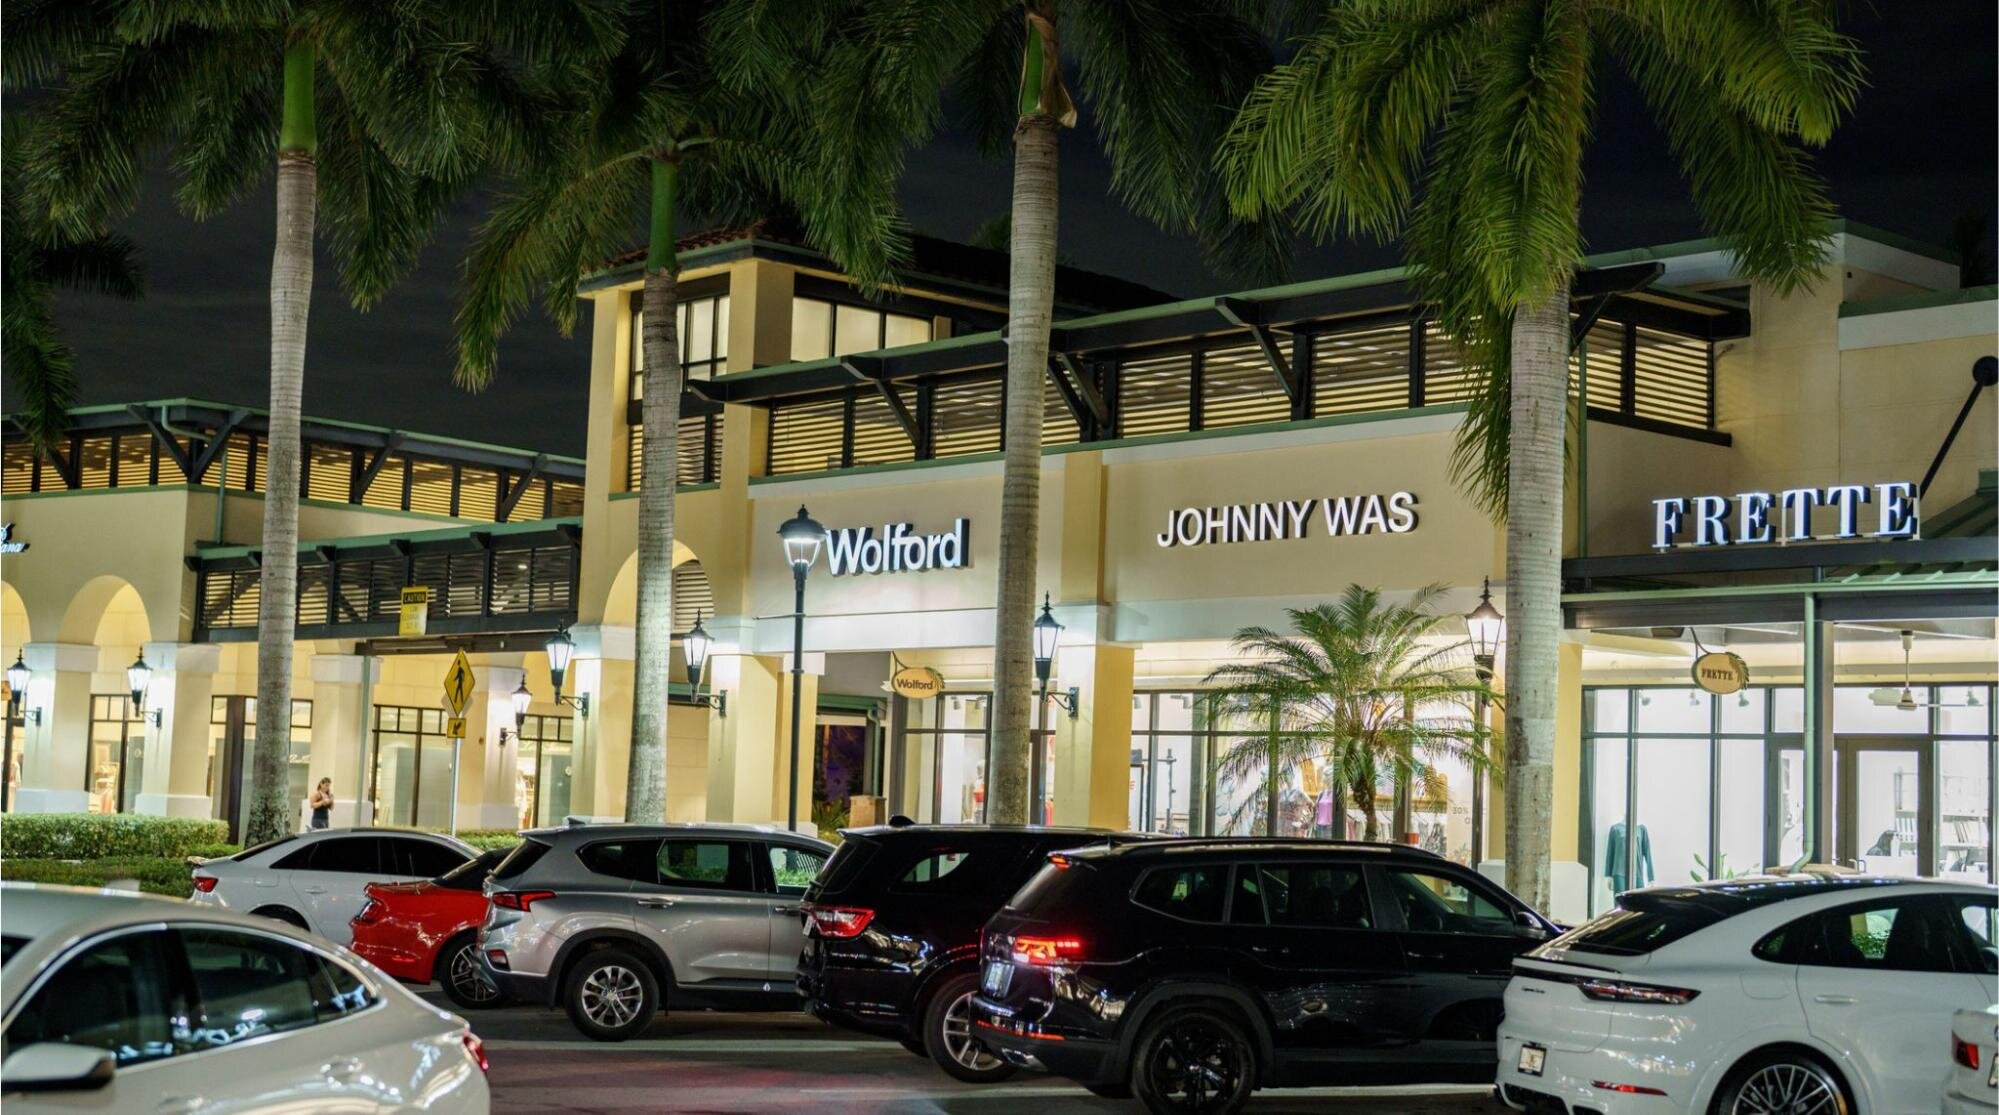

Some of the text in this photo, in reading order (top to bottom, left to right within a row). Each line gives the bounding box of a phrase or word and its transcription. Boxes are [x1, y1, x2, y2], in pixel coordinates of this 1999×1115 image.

[1157, 491, 1418, 548] JOHNNY WAS
[1652, 482, 1918, 548] FRETTE
[826, 518, 970, 576] Wolford
[897, 678, 933, 690] Wolford
